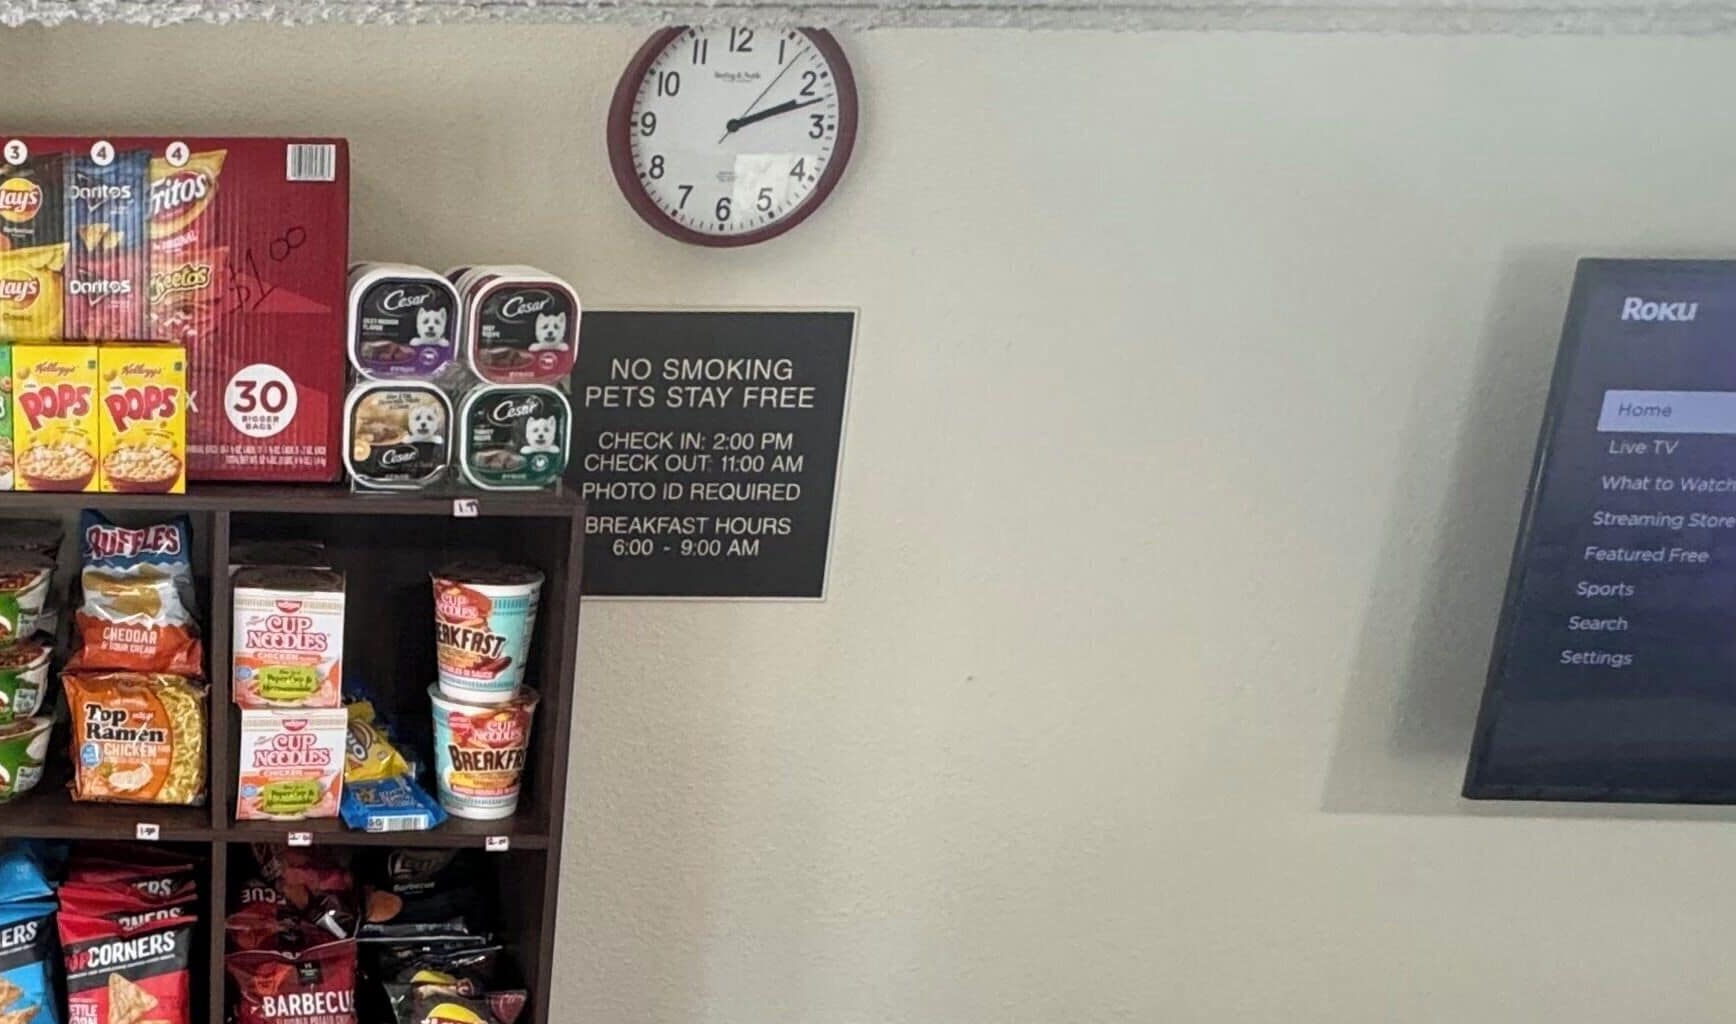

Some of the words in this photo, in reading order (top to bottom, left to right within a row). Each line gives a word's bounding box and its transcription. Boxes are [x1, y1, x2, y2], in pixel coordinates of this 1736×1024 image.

[729, 27, 754, 52] 12
[693, 39, 708, 64] 11
[779, 39, 786, 64] 1
[658, 71, 680, 96] 10
[800, 71, 817, 96] 2
[641, 112, 657, 136] 9
[809, 114, 825, 139] 3
[10, 144, 21, 160] 3
[96, 145, 109, 161] 4
[170, 145, 183, 161] 4
[649, 155, 665, 179] 8
[790, 158, 805, 182] 4
[70, 182, 131, 201] Doritos
[678, 185, 694, 209] 7
[756, 188, 773, 211] 5
[716, 197, 732, 221] 6
[70, 277, 131, 295] Doritos
[384, 290, 430, 311] Cesar
[502, 296, 548, 318] Cesar
[611, 358, 652, 380] NO
[662, 358, 793, 380] SMOKING
[234, 381, 289, 413] 30
[585, 386, 655, 408] PETS
[666, 386, 733, 408] STAY
[743, 386, 815, 408] FREE
[20, 385, 93, 429] POPS
[105, 386, 178, 431] POPS
[492, 400, 538, 421] Cesar
[1618, 402, 1672, 418] Home
[598, 431, 674, 450] CHECK
[680, 432, 706, 450] IN:
[713, 432, 754, 450] 2:00
[761, 432, 793, 450] PM
[1609, 439, 1646, 456] Live
[1651, 440, 1679, 455] TV
[382, 449, 417, 465] Cesar
[584, 454, 658, 472] CHECK
[665, 454, 712, 472] OUT:
[721, 455, 764, 472] 11:00
[770, 455, 804, 472] AM
[582, 482, 656, 500] PHOTO
[664, 483, 684, 500] ID
[690, 483, 801, 501] REQUIRED
[1602, 475, 1651, 492] What
[1656, 477, 1674, 492] to
[1680, 476, 1736, 492] Watch
[585, 516, 708, 535] BREAKFAST
[716, 517, 792, 535] HOURS
[1593, 511, 1684, 530] Streaming
[1687, 513, 1736, 529] Store
[85, 525, 180, 559] RUFFLES
[612, 538, 653, 556] 6:00
[680, 538, 721, 556] 9:00
[727, 539, 760, 556] AM
[1584, 546, 1664, 562] Featured
[1668, 548, 1710, 563] Free
[1577, 580, 1634, 599] Sports
[440, 593, 467, 606] CUP
[264, 616, 313, 633] CUP
[1568, 615, 1628, 632] Search
[103, 627, 158, 645] CHEDDAR
[246, 630, 328, 651] NOODLES
[1560, 649, 1633, 668] Settings
[86, 704, 127, 724] Top
[86, 723, 164, 743] Ramen
[486, 720, 517, 733] CUP
[103, 743, 158, 758] CHICKEN
[271, 733, 317, 750] CUP
[252, 748, 330, 768] NOODLES
